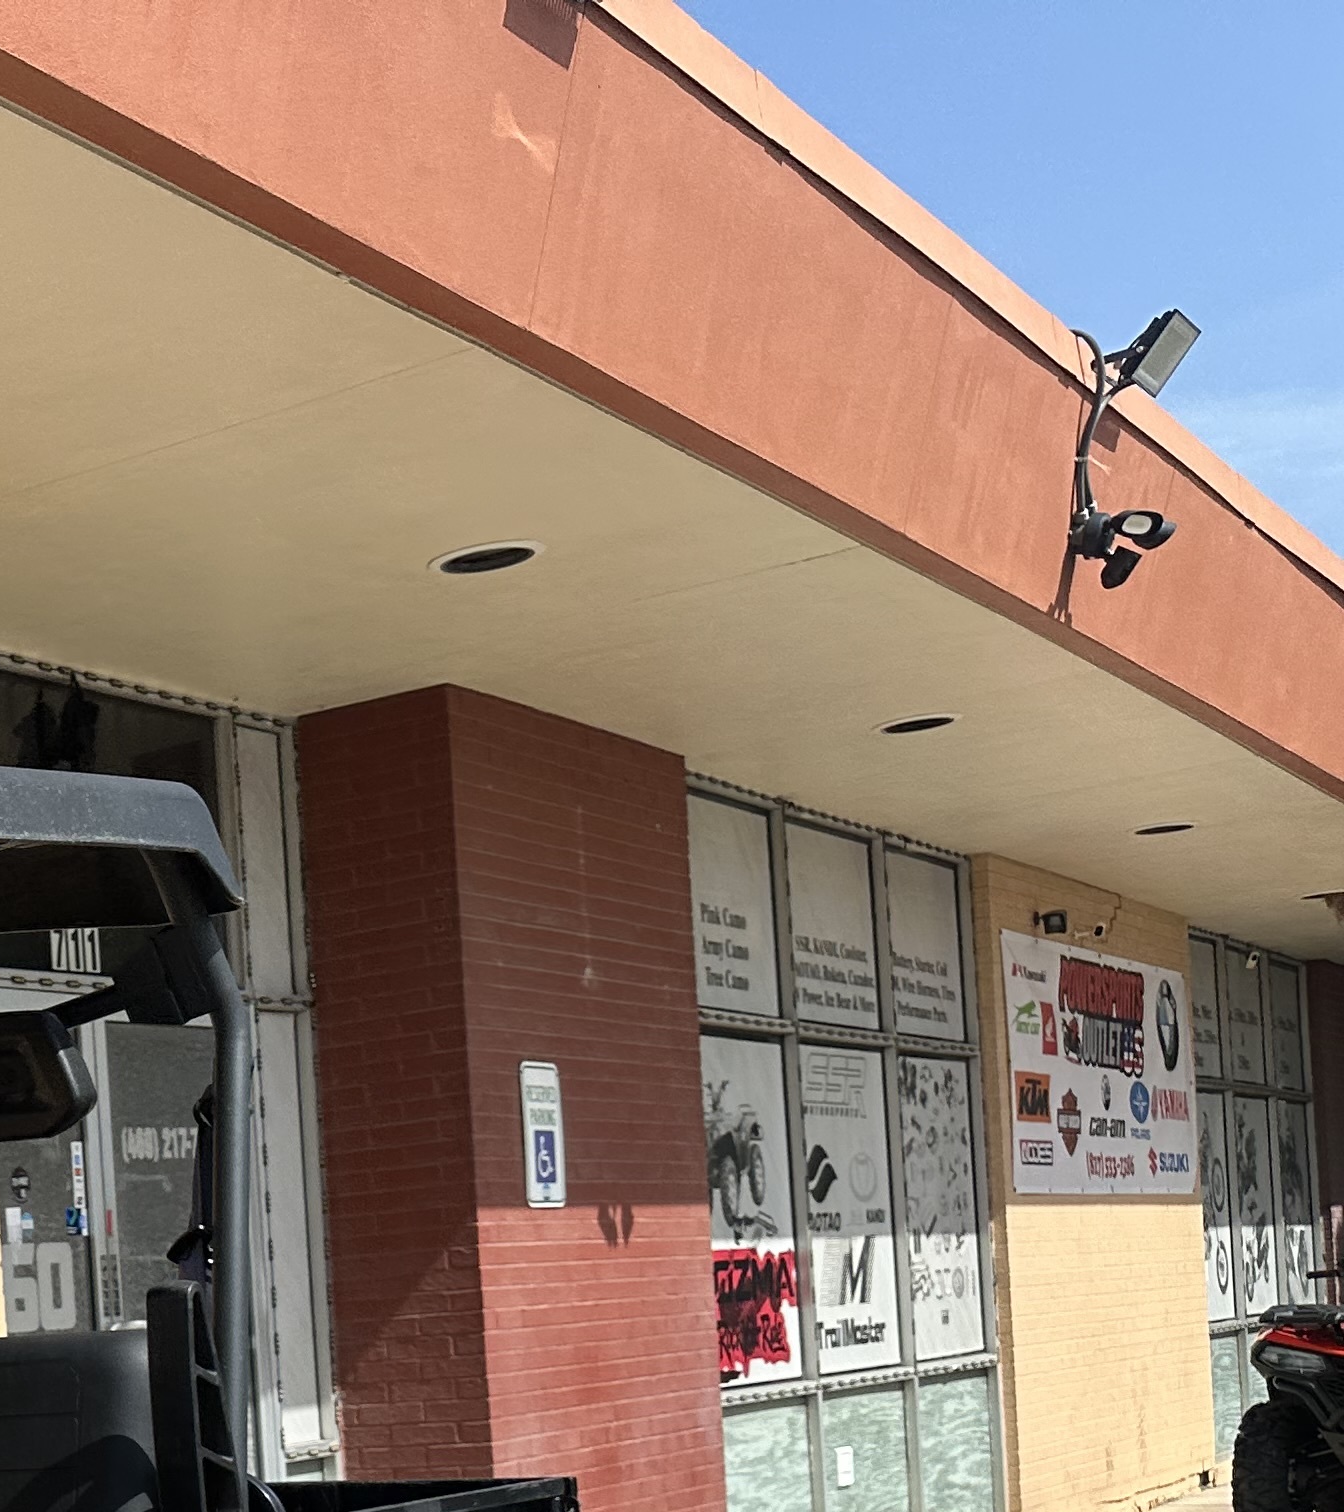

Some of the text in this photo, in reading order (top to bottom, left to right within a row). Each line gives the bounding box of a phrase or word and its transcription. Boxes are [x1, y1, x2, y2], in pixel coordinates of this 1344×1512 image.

[53, 929, 97, 971] 711
[1059, 958, 1145, 1026] POWERSPORTS
[1019, 1078, 1051, 1118] KTM
[1089, 1116, 1126, 1138] can-am
[1159, 1151, 1190, 1173] SUZUKI
